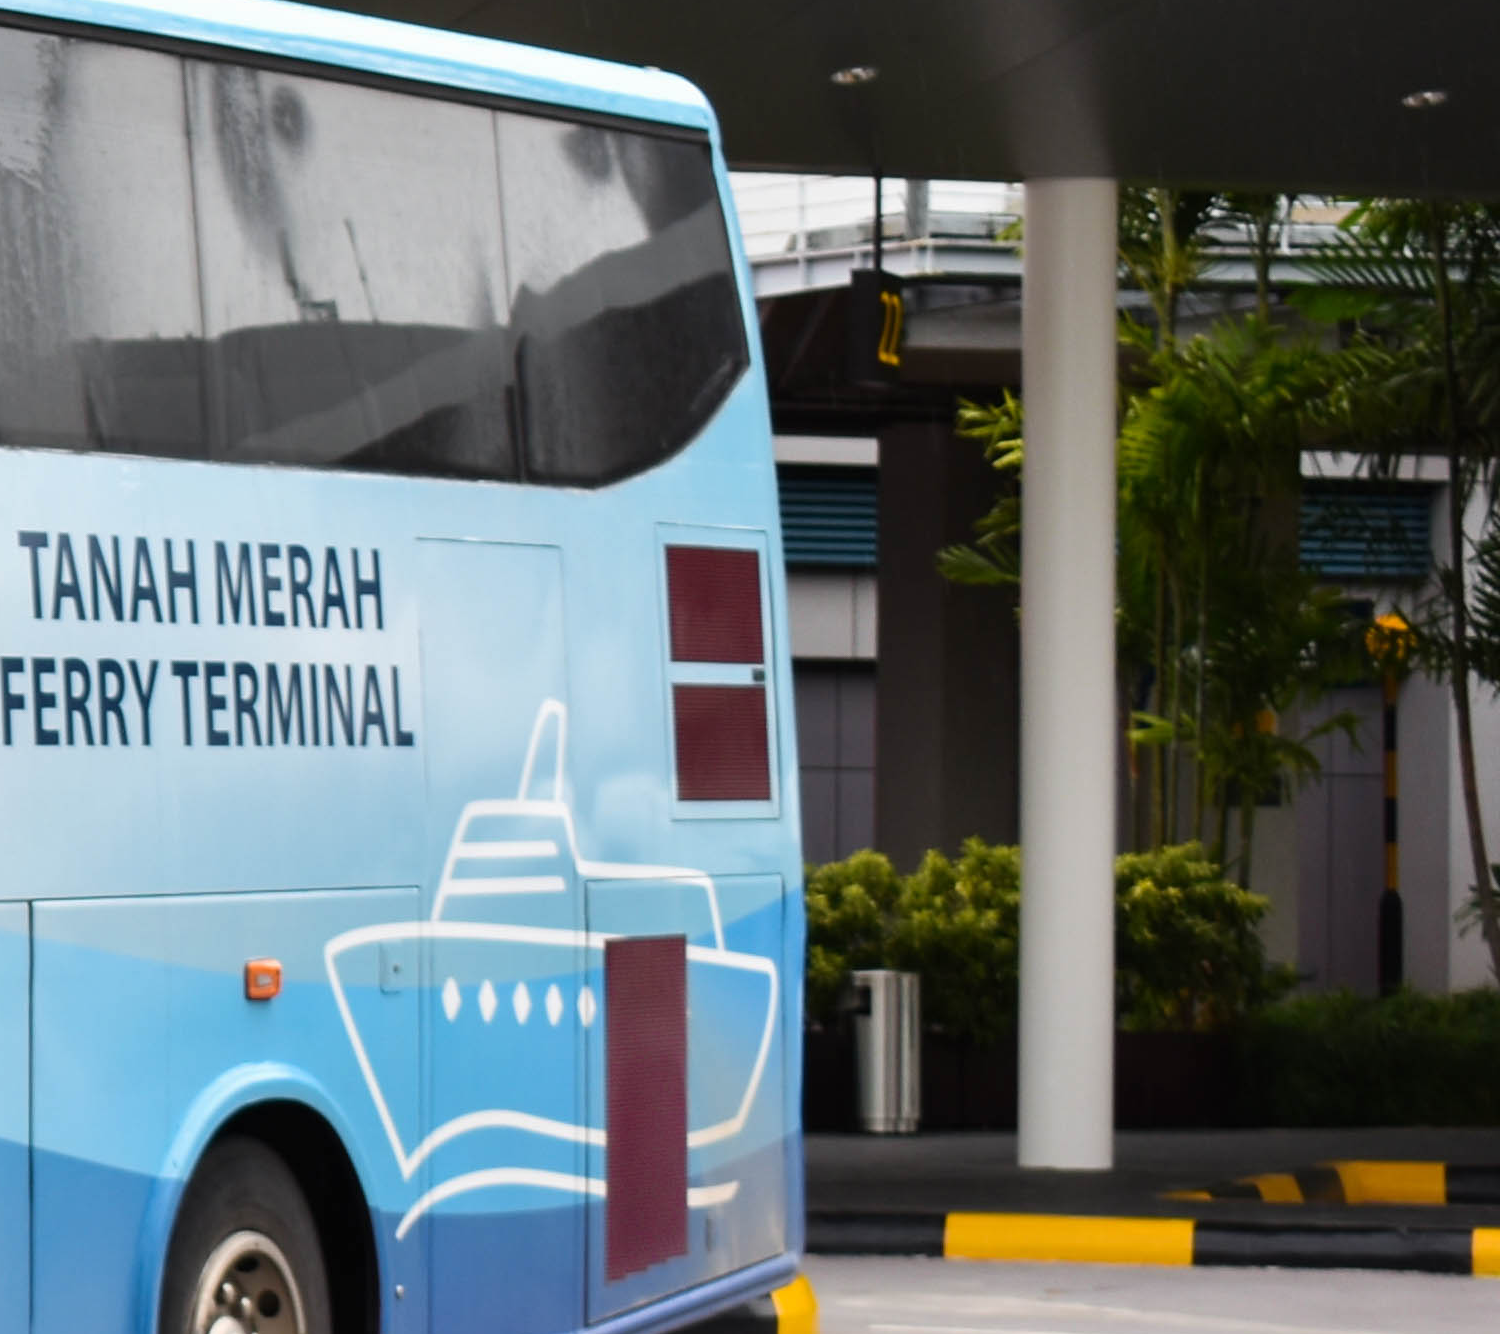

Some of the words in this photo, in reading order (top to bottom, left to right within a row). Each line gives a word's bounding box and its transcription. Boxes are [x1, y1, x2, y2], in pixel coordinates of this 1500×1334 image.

[16, 529, 198, 626] TANAH
[214, 539, 386, 632] MERAH
[0, 654, 161, 748] FERRY
[167, 658, 415, 748] TERMINAL
